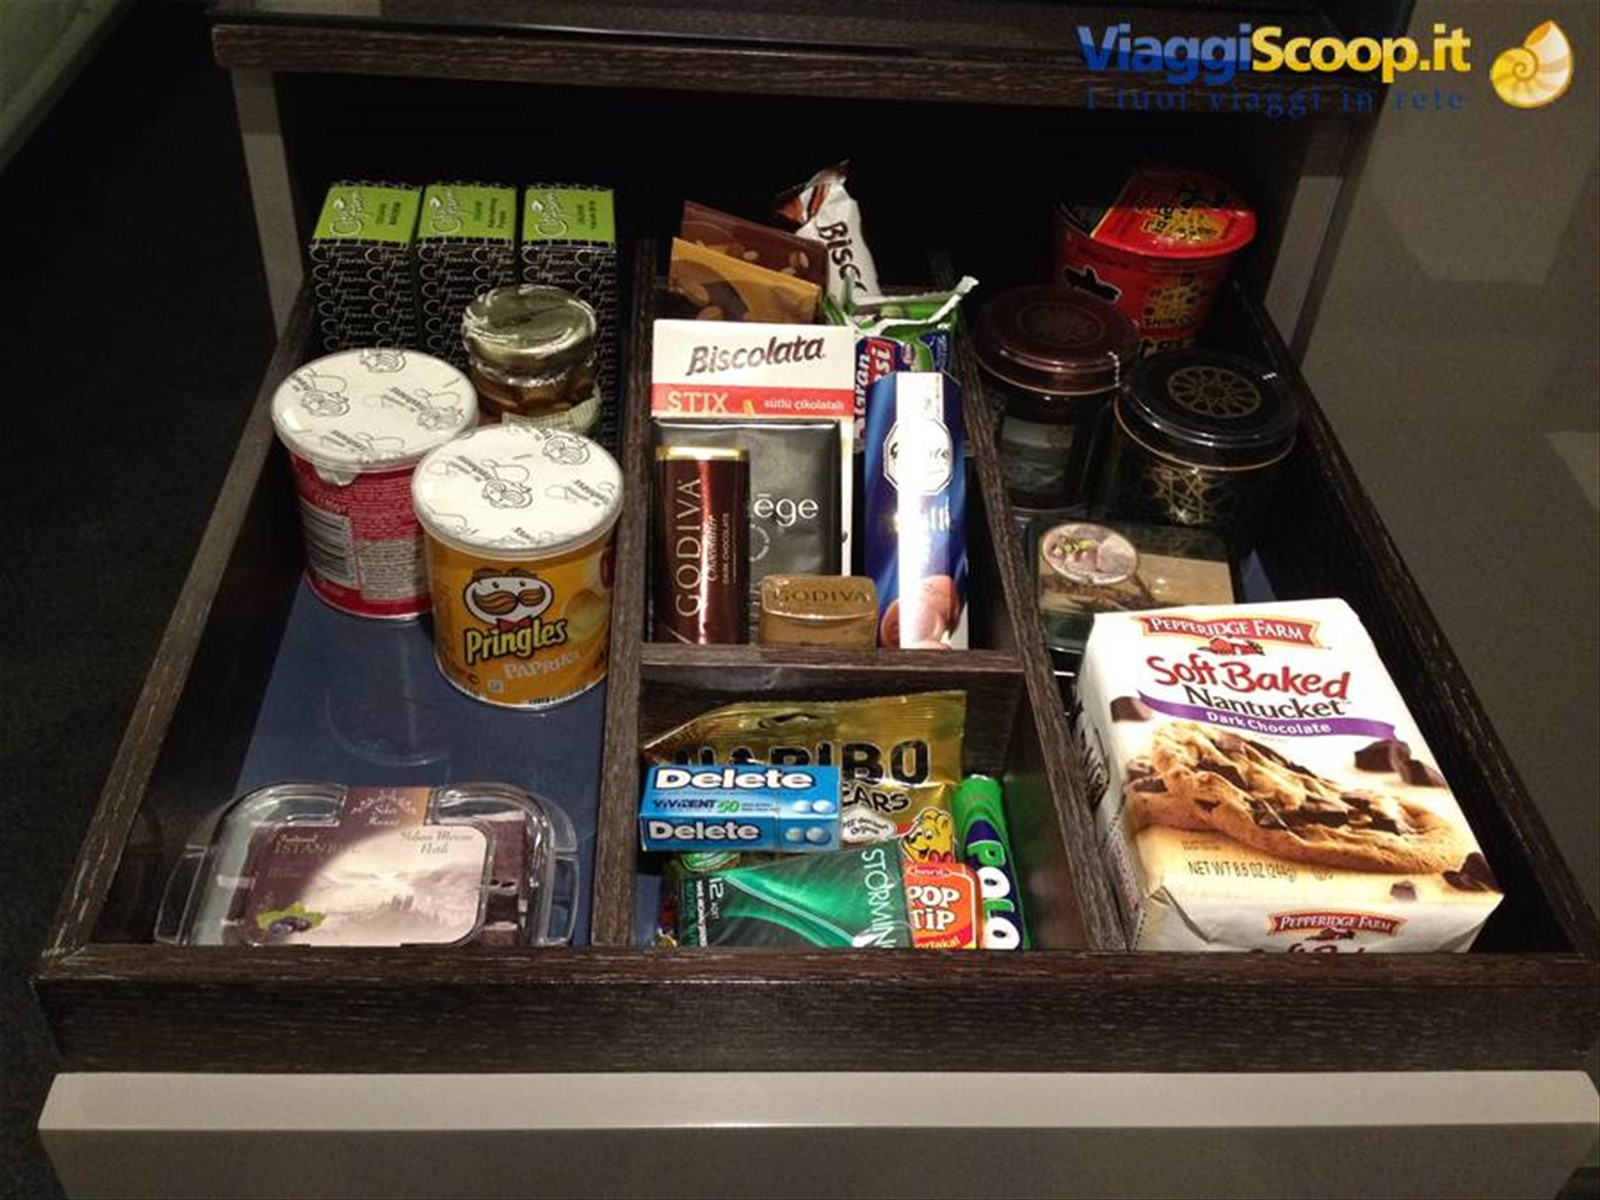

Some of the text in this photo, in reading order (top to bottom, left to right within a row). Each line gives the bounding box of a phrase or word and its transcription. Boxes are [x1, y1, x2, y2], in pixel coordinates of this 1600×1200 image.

[686, 335, 826, 376] Biscolata
[667, 391, 729, 414] STIX
[676, 478, 702, 617] GODIVA
[465, 617, 568, 665] Pringles
[1146, 653, 1351, 699] Soft Baked
[1182, 684, 1346, 719] Nantucket
[1207, 711, 1332, 735] Dark Chocolate
[655, 766, 815, 790] Delete
[648, 820, 761, 842] Delete
[1188, 861, 1211, 876] NET
[1211, 861, 1231, 877] WT
[1249, 862, 1266, 878] OZ
[708, 877, 724, 899] 12
[906, 885, 960, 908] POP
[966, 839, 1021, 950] POLO
